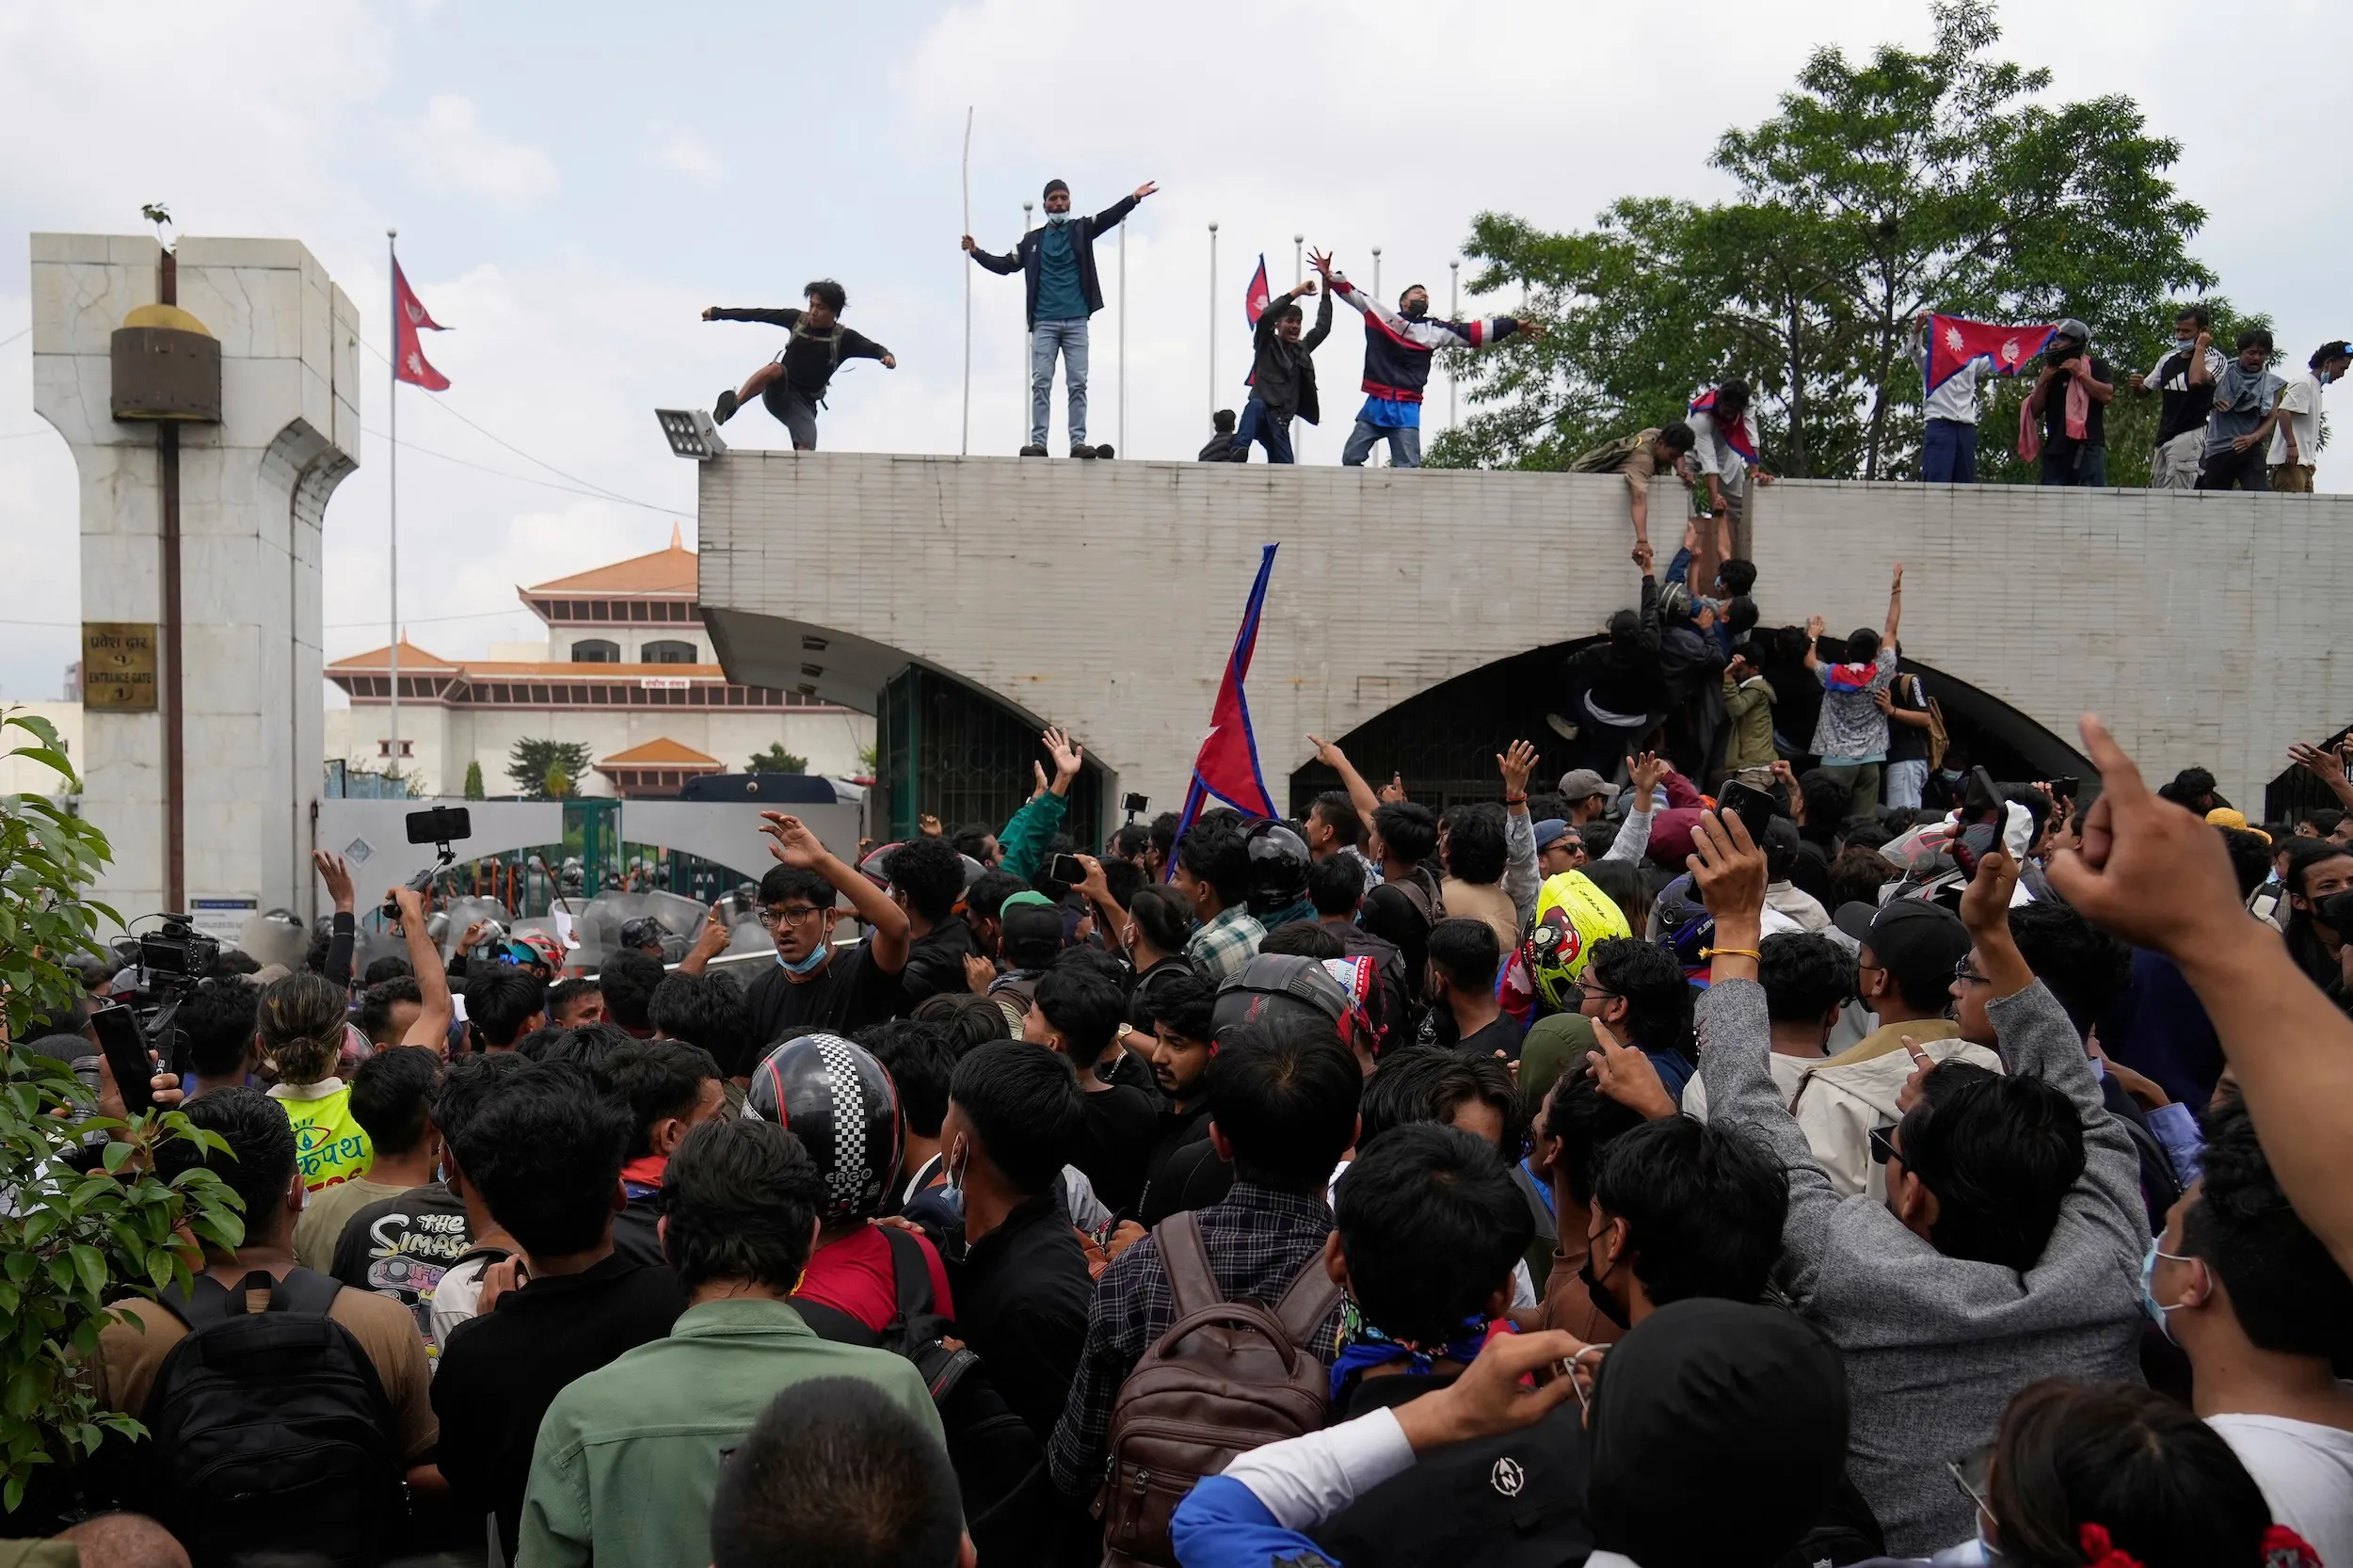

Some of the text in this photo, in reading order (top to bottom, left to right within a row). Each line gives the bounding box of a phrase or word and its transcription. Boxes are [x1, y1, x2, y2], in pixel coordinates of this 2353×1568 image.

[88, 672, 152, 683] ENTRANCE GATE
[824, 1168, 873, 1184] ERGO
